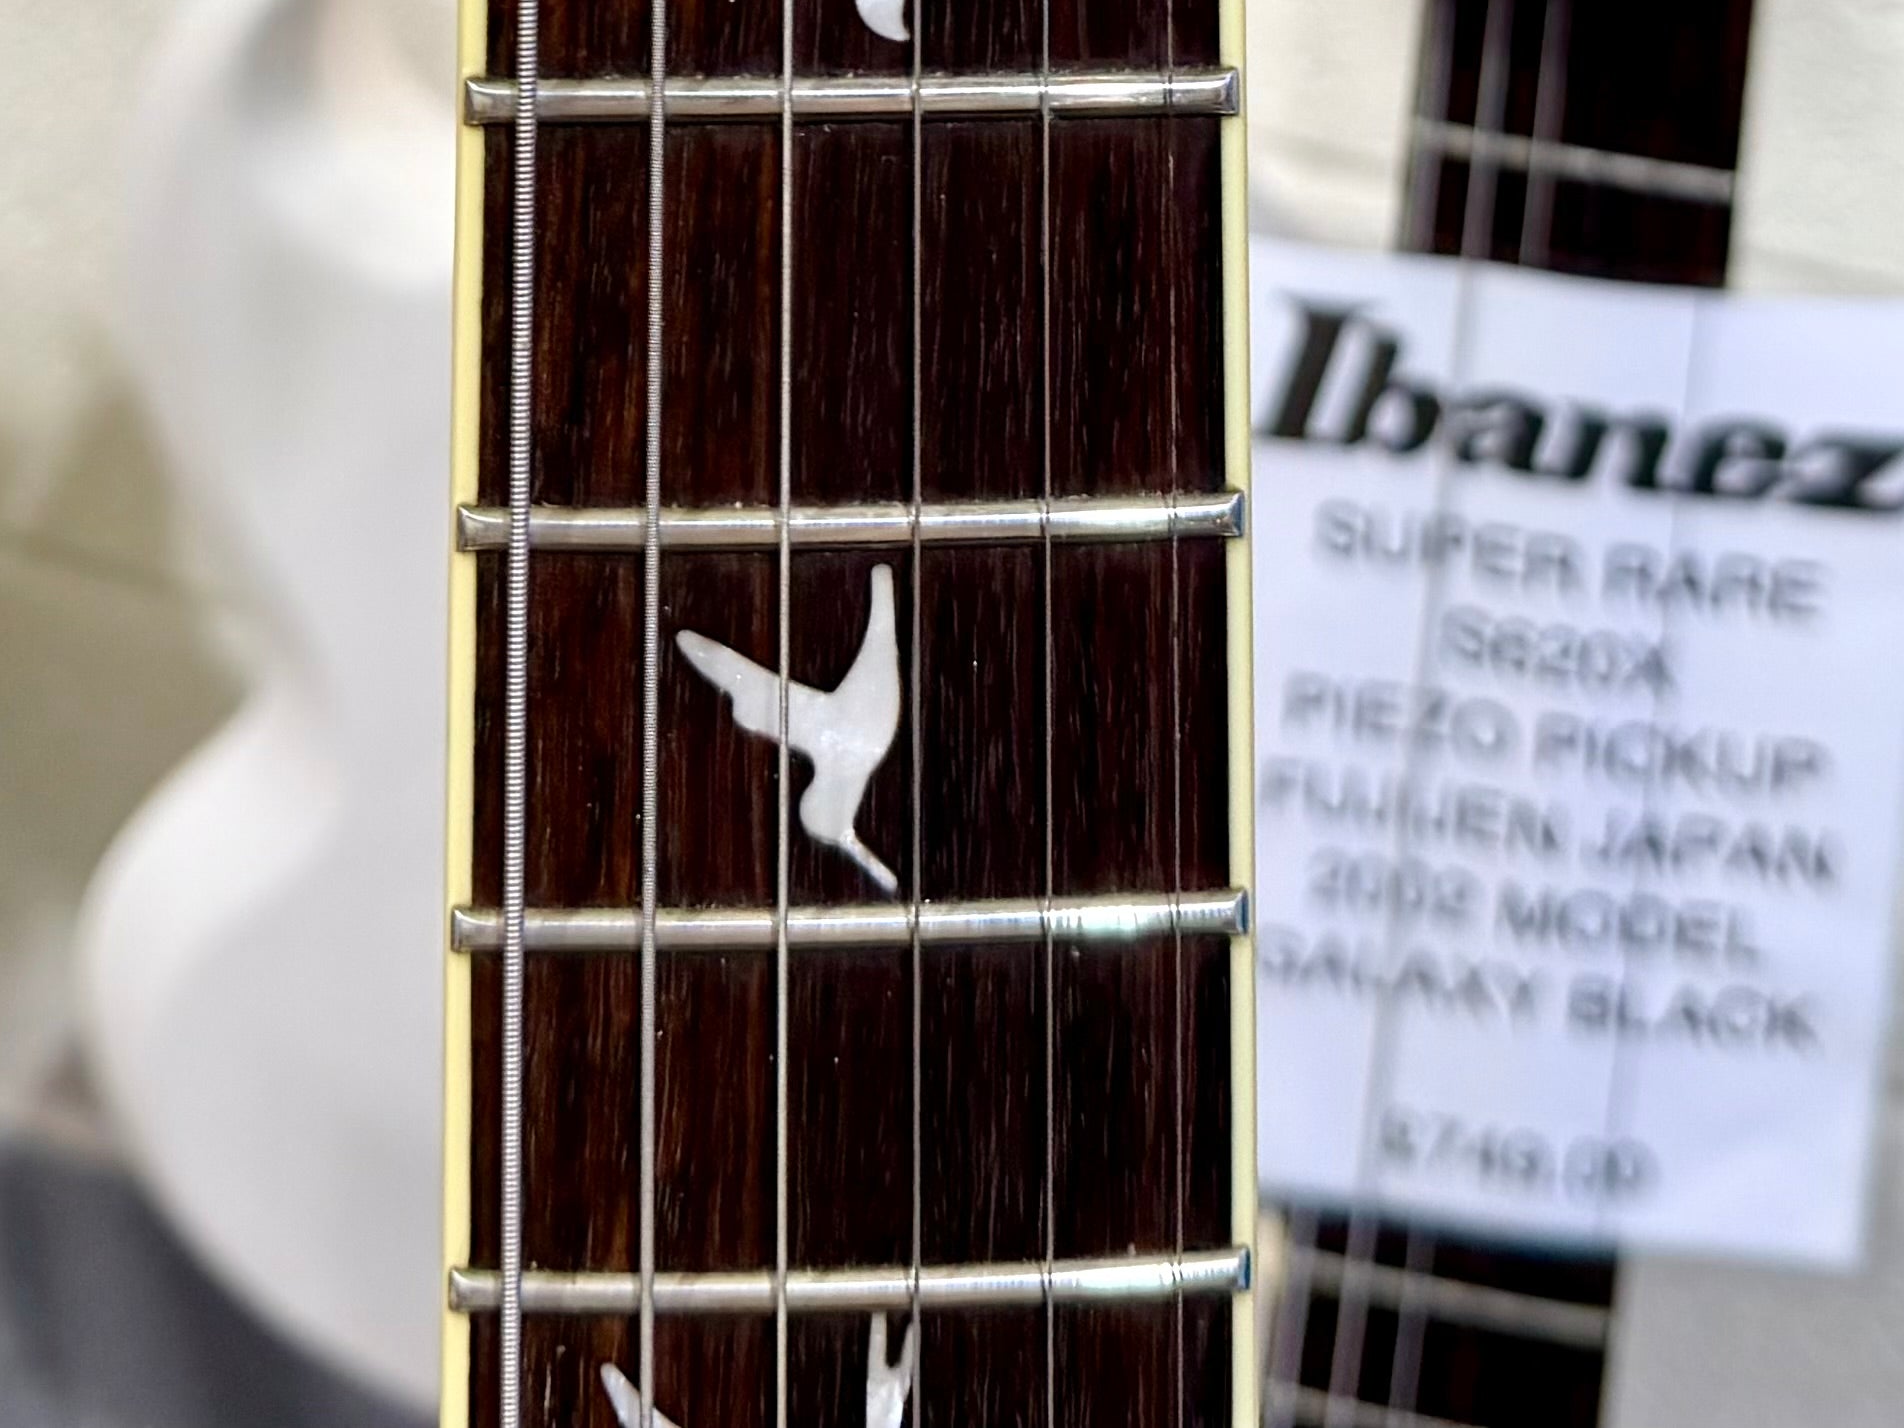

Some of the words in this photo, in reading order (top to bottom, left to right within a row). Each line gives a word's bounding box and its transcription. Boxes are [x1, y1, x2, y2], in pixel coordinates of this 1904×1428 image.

[1318, 500, 1577, 592] SUPER
[1605, 544, 1823, 618] RARE
[1286, 675, 1514, 758] PIEZO
[1537, 716, 1828, 790] PICKUP
[1584, 812, 1836, 884] JAPAN
[1503, 882, 1756, 963] MODEL
[1259, 928, 1542, 1024] GALAXY
[1572, 978, 1820, 1048] BLACK
